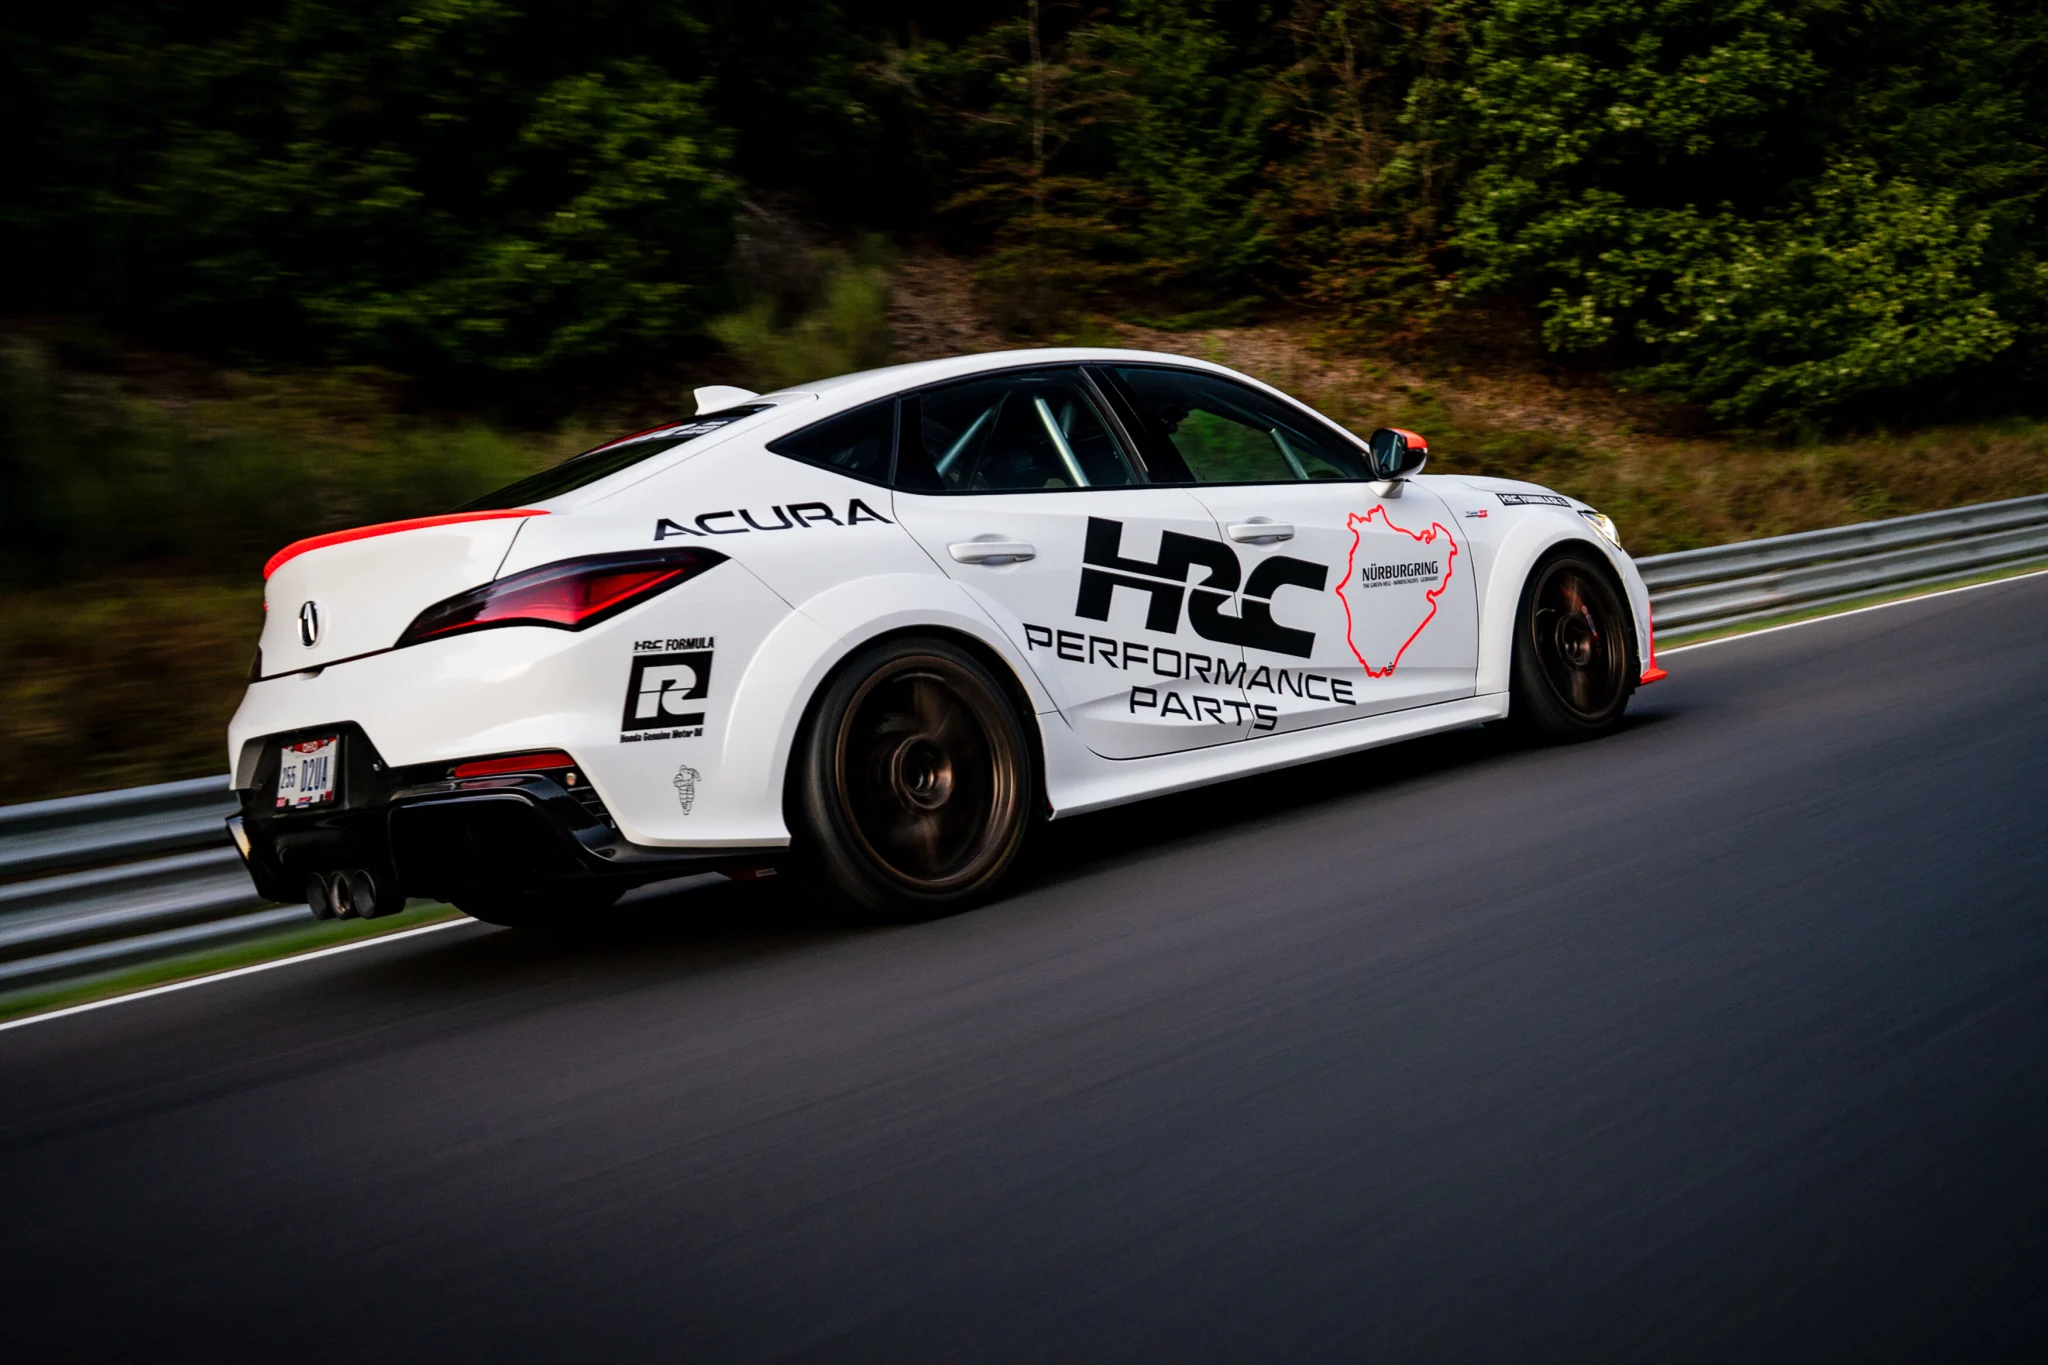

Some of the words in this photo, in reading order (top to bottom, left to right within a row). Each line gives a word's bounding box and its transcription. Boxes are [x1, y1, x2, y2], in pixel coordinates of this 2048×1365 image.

[653, 498, 895, 541] ACURA
[1075, 516, 1329, 659] HRC
[1362, 561, 1438, 582] NÜRBURGRING
[634, 640, 664, 651] HRC
[666, 637, 715, 651] FORMULA
[1022, 623, 1357, 705] PERFORMANCE
[1130, 685, 1278, 731] PARTS
[620, 733, 642, 743] Honda
[643, 731, 671, 741] Genuine
[672, 729, 693, 738] Motor
